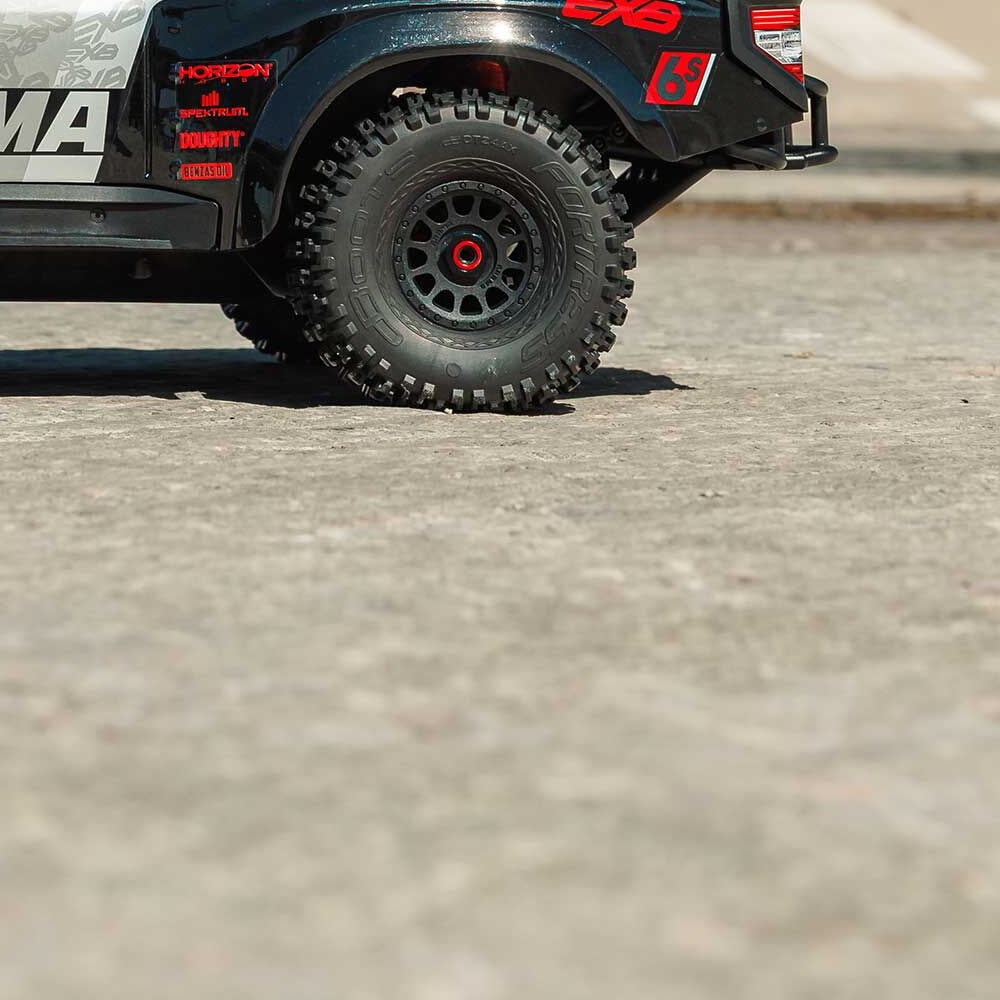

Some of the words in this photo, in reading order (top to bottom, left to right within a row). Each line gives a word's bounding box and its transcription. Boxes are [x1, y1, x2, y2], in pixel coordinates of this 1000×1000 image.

[178, 63, 270, 79] HORIZON
[179, 107, 249, 118] SPEKTRUM
[179, 130, 241, 149] DOUGHTY
[216, 165, 229, 176] OIL
